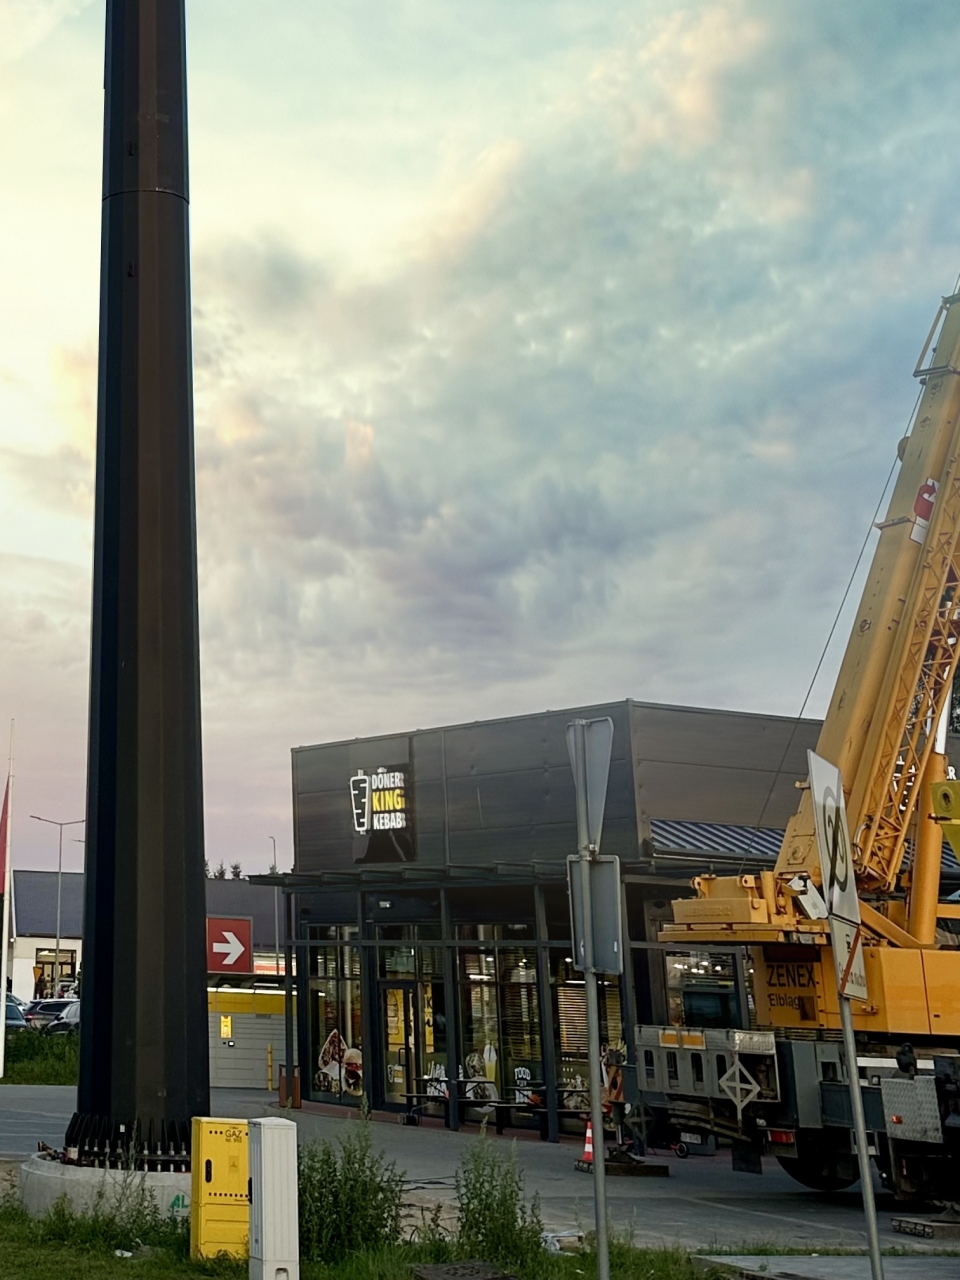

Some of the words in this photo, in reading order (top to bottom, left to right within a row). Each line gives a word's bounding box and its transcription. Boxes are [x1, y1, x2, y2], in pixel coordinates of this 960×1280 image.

[372, 788, 405, 812] KING
[373, 812, 406, 830] KEBAB
[766, 964, 816, 988] ZENEX
[224, 1129, 243, 1139] GAZ
